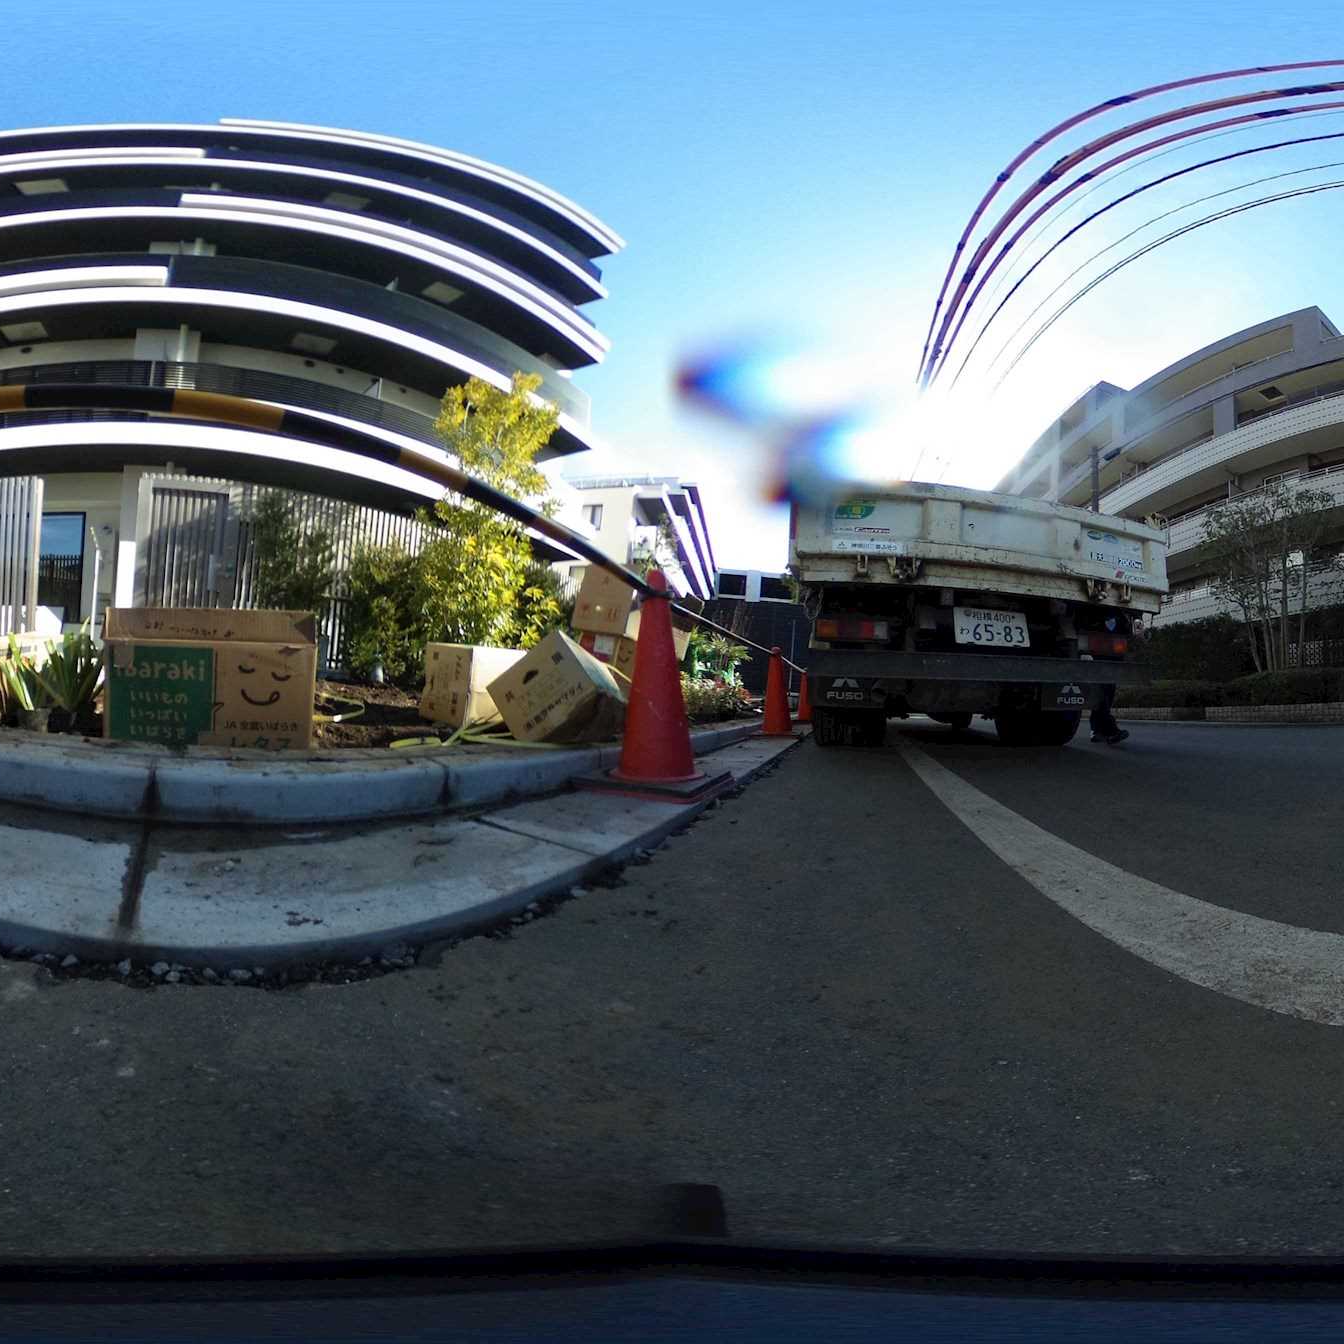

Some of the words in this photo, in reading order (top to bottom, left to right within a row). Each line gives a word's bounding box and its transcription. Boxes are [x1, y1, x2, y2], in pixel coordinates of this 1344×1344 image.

[972, 623, 1026, 644] 65-83
[826, 691, 864, 701] FUSO
[1056, 696, 1085, 705] FUSO
